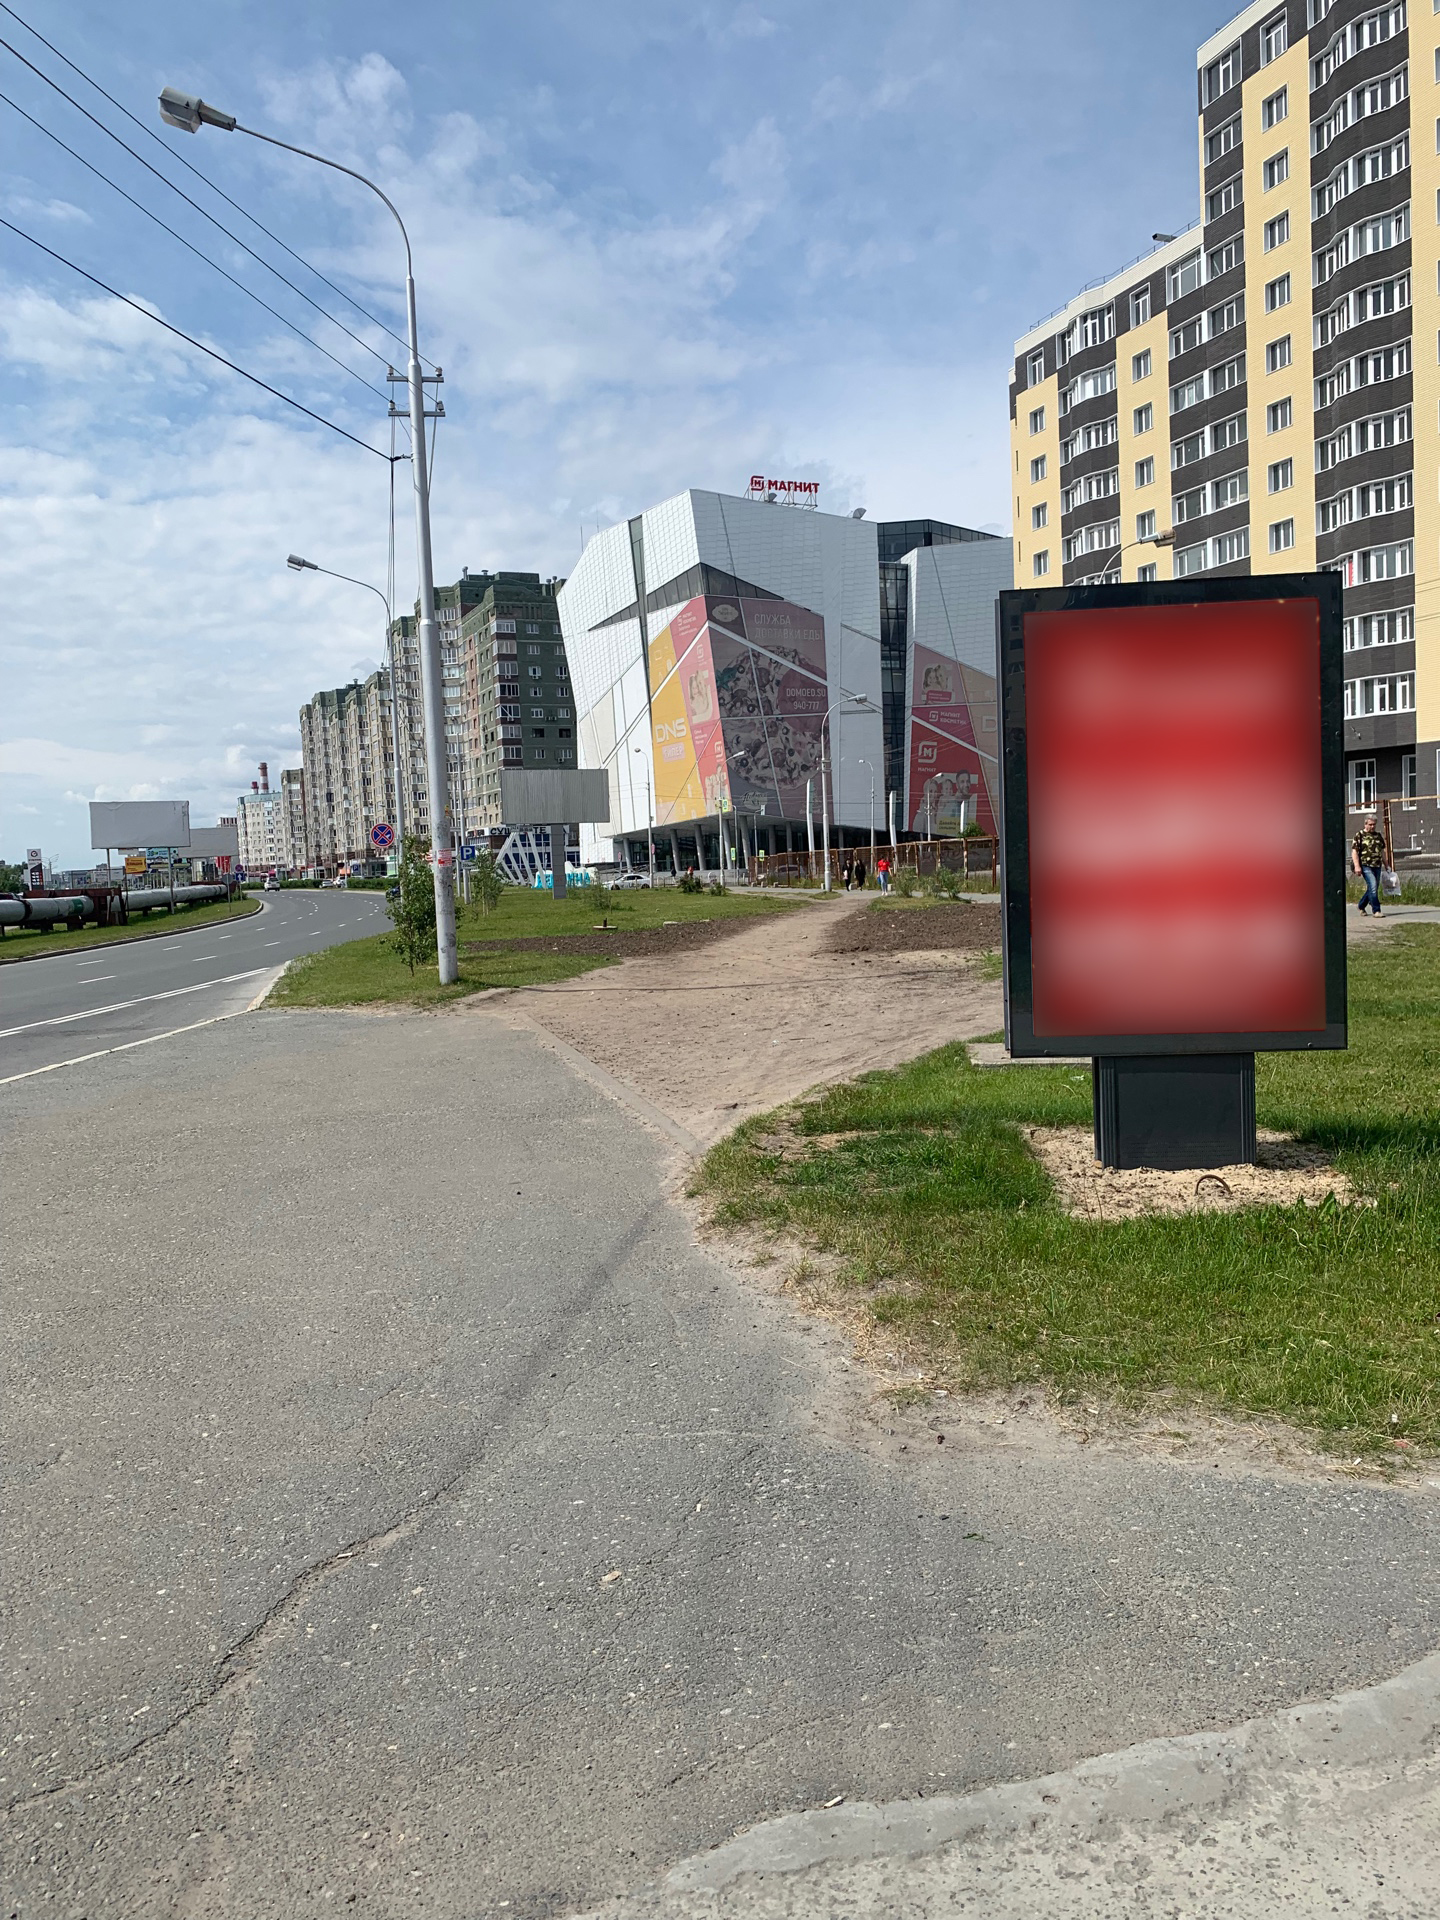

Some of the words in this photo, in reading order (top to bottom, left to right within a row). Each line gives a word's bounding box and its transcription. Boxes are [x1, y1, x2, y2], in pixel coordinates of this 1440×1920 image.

[768, 479, 820, 493] МАГНИТ
[754, 613, 792, 625] СЛУЖБА
[754, 627, 801, 640] ДОСТАВКИ
[803, 629, 824, 641] ЕДЫ
[786, 688, 827, 698] DOMOED.SU
[793, 701, 820, 711] 940-777
[655, 717, 687, 744] DNS
